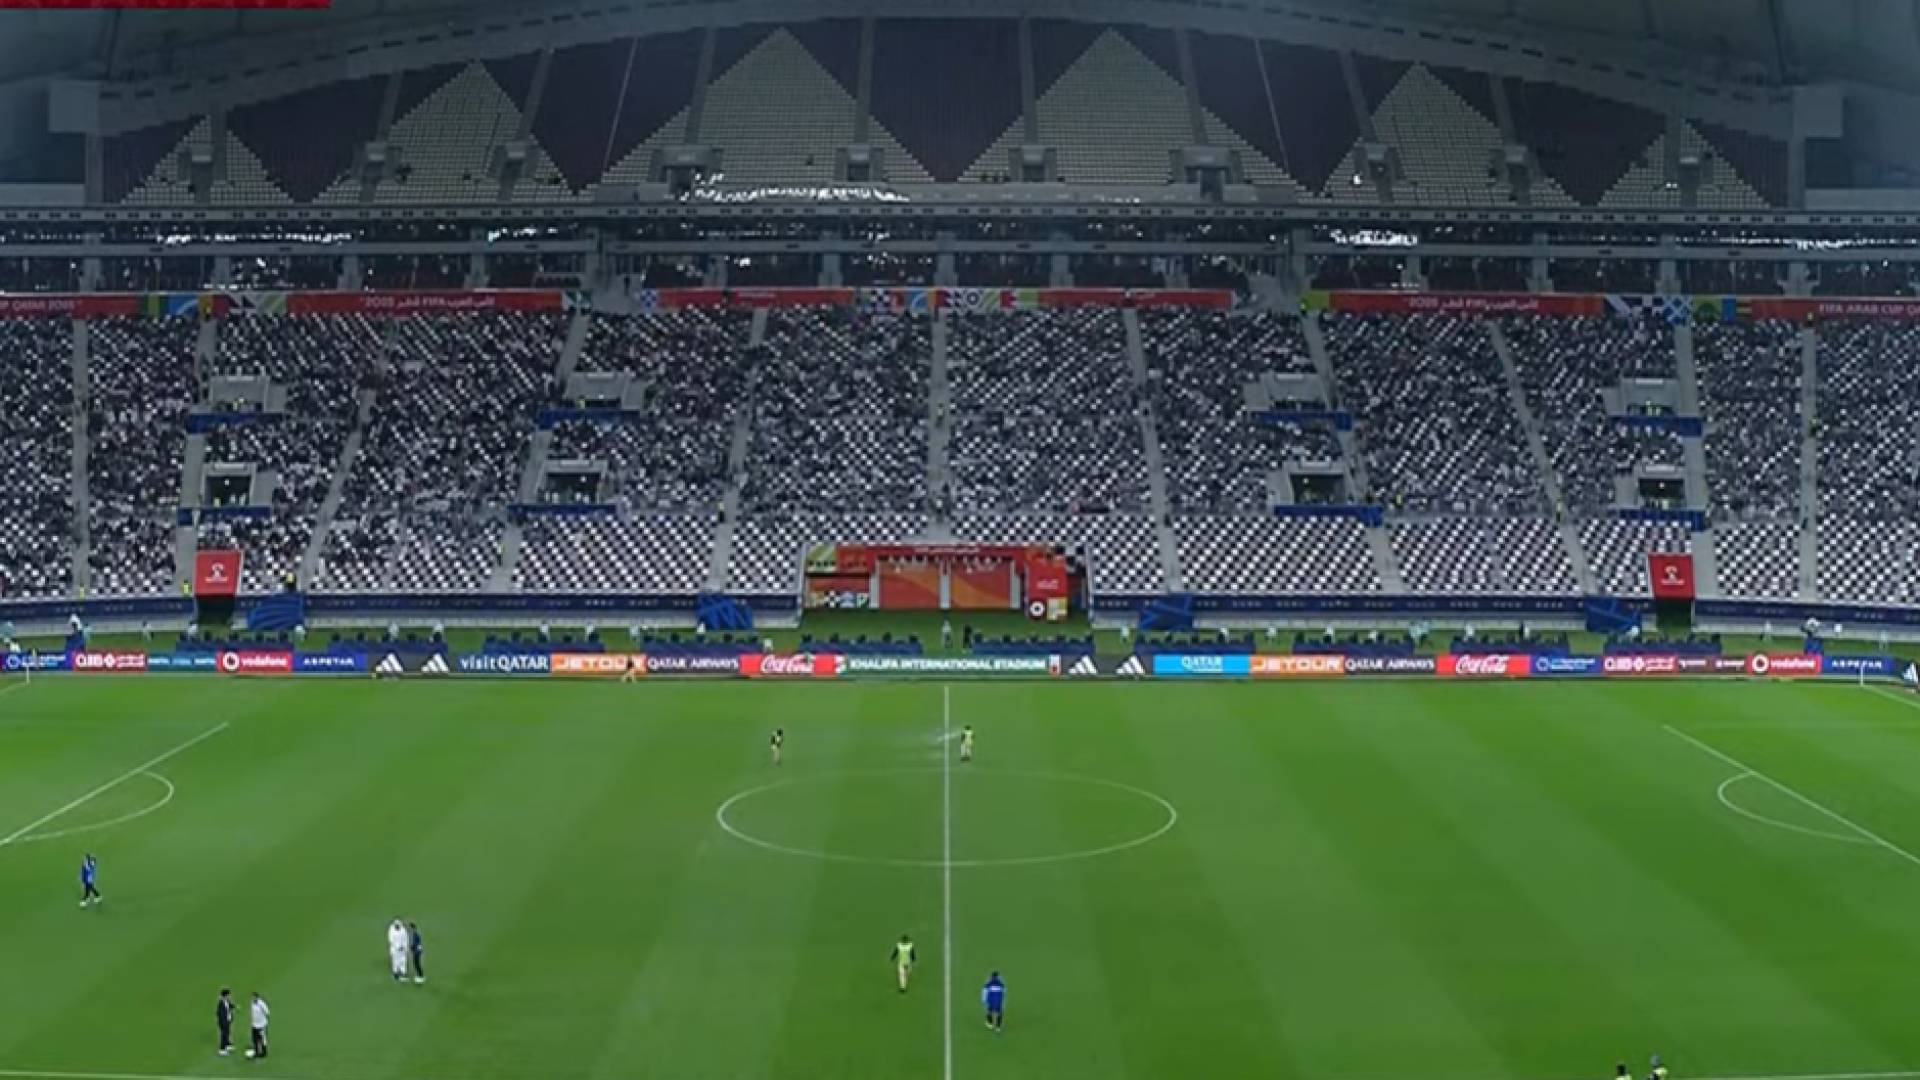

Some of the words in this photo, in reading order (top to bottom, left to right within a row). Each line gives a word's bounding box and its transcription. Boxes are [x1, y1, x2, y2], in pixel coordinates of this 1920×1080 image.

[1819, 303, 1843, 314] FIFA
[1880, 303, 1905, 314] CUP
[240, 655, 288, 668] vodafone
[302, 656, 355, 667] ASPETAR
[647, 657, 687, 671] QATAR
[690, 657, 738, 670] AIRWAYS
[850, 658, 898, 670] KHALIFA
[901, 658, 991, 671] INTERNATIONAL
[994, 658, 1046, 671] STADIUM
[1252, 656, 1343, 672] JETOUR
[1345, 658, 1384, 672] QATAR
[1387, 658, 1434, 671] AIRWAYS
[1769, 657, 1815, 669] vodafone
